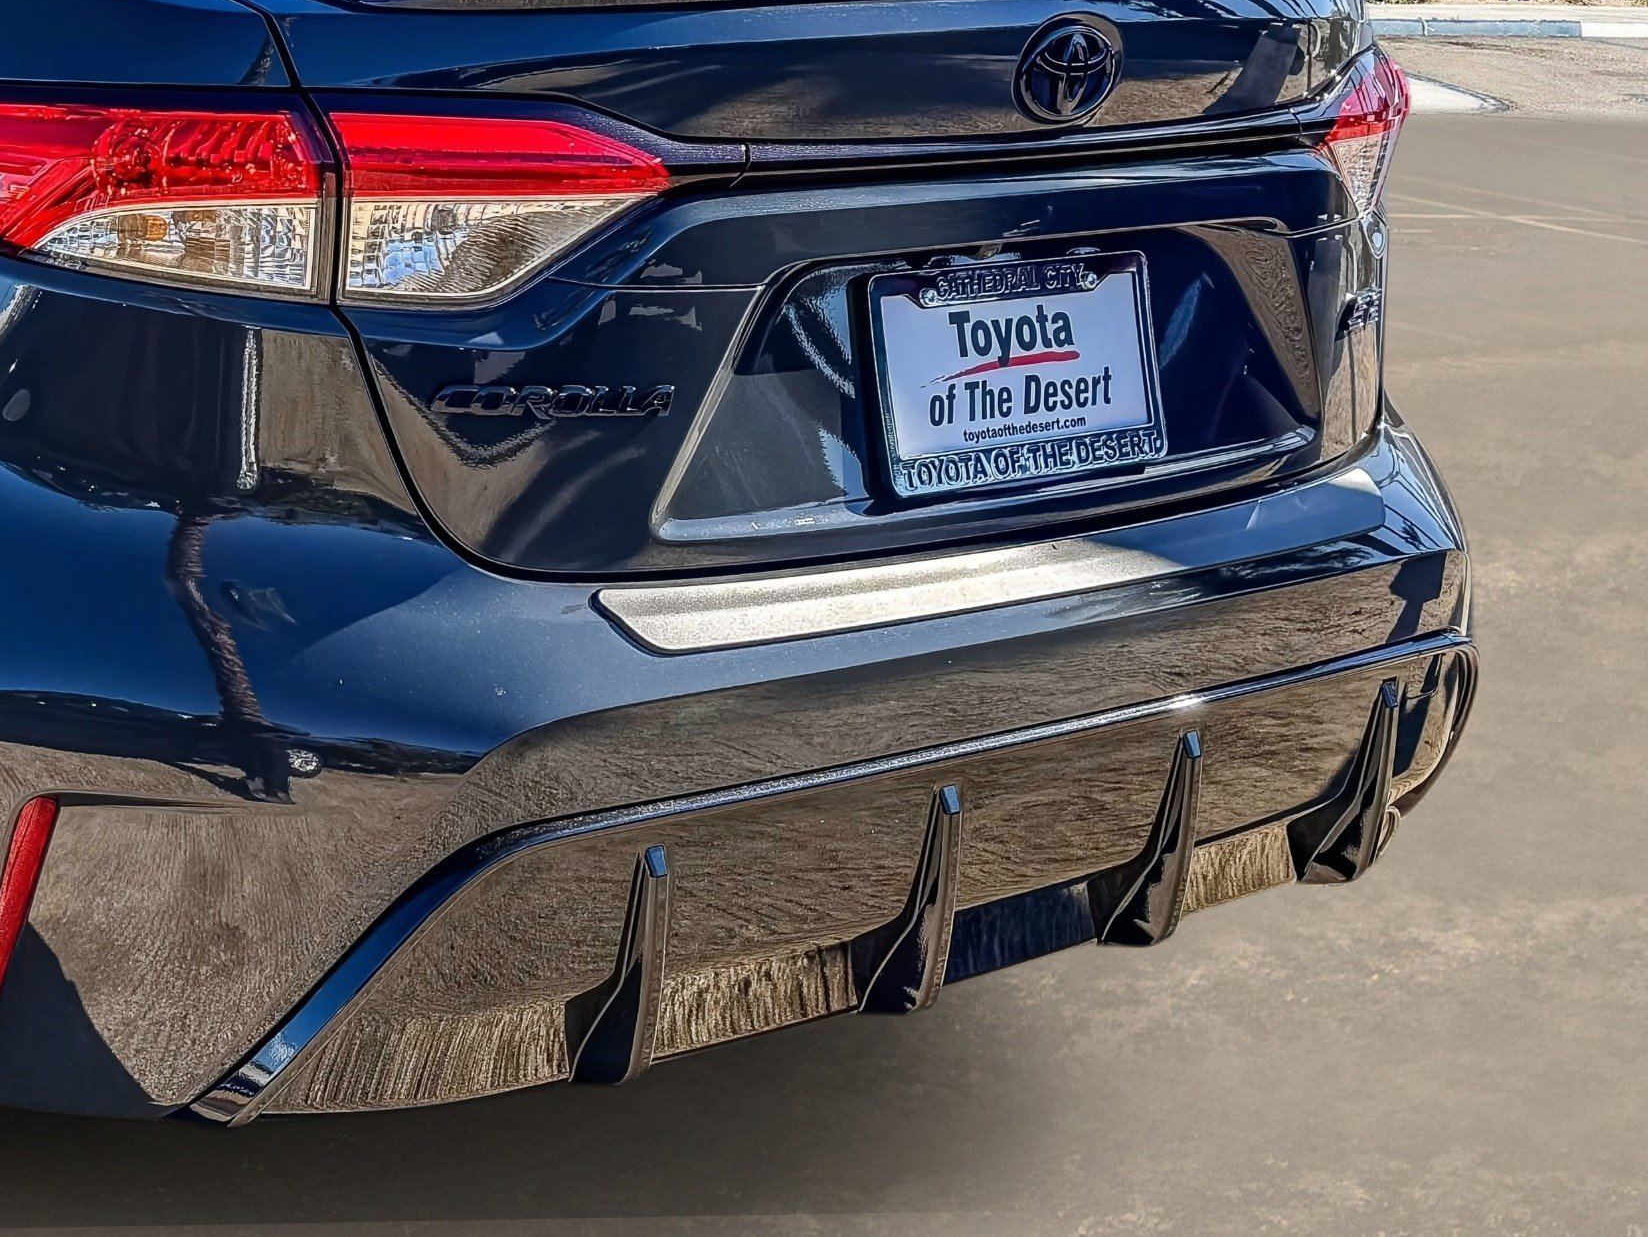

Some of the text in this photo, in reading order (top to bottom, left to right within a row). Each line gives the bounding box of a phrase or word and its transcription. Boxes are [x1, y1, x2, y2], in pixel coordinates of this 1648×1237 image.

[935, 263, 1086, 300] CATHEDRAL CITY
[948, 304, 1075, 368] Toyota
[429, 384, 675, 419] COROLLA
[929, 366, 1112, 427] of The Desert
[963, 415, 1087, 444] toyotaofthedesert.com
[901, 431, 1157, 491] TOYOTA OF THE DESERT
